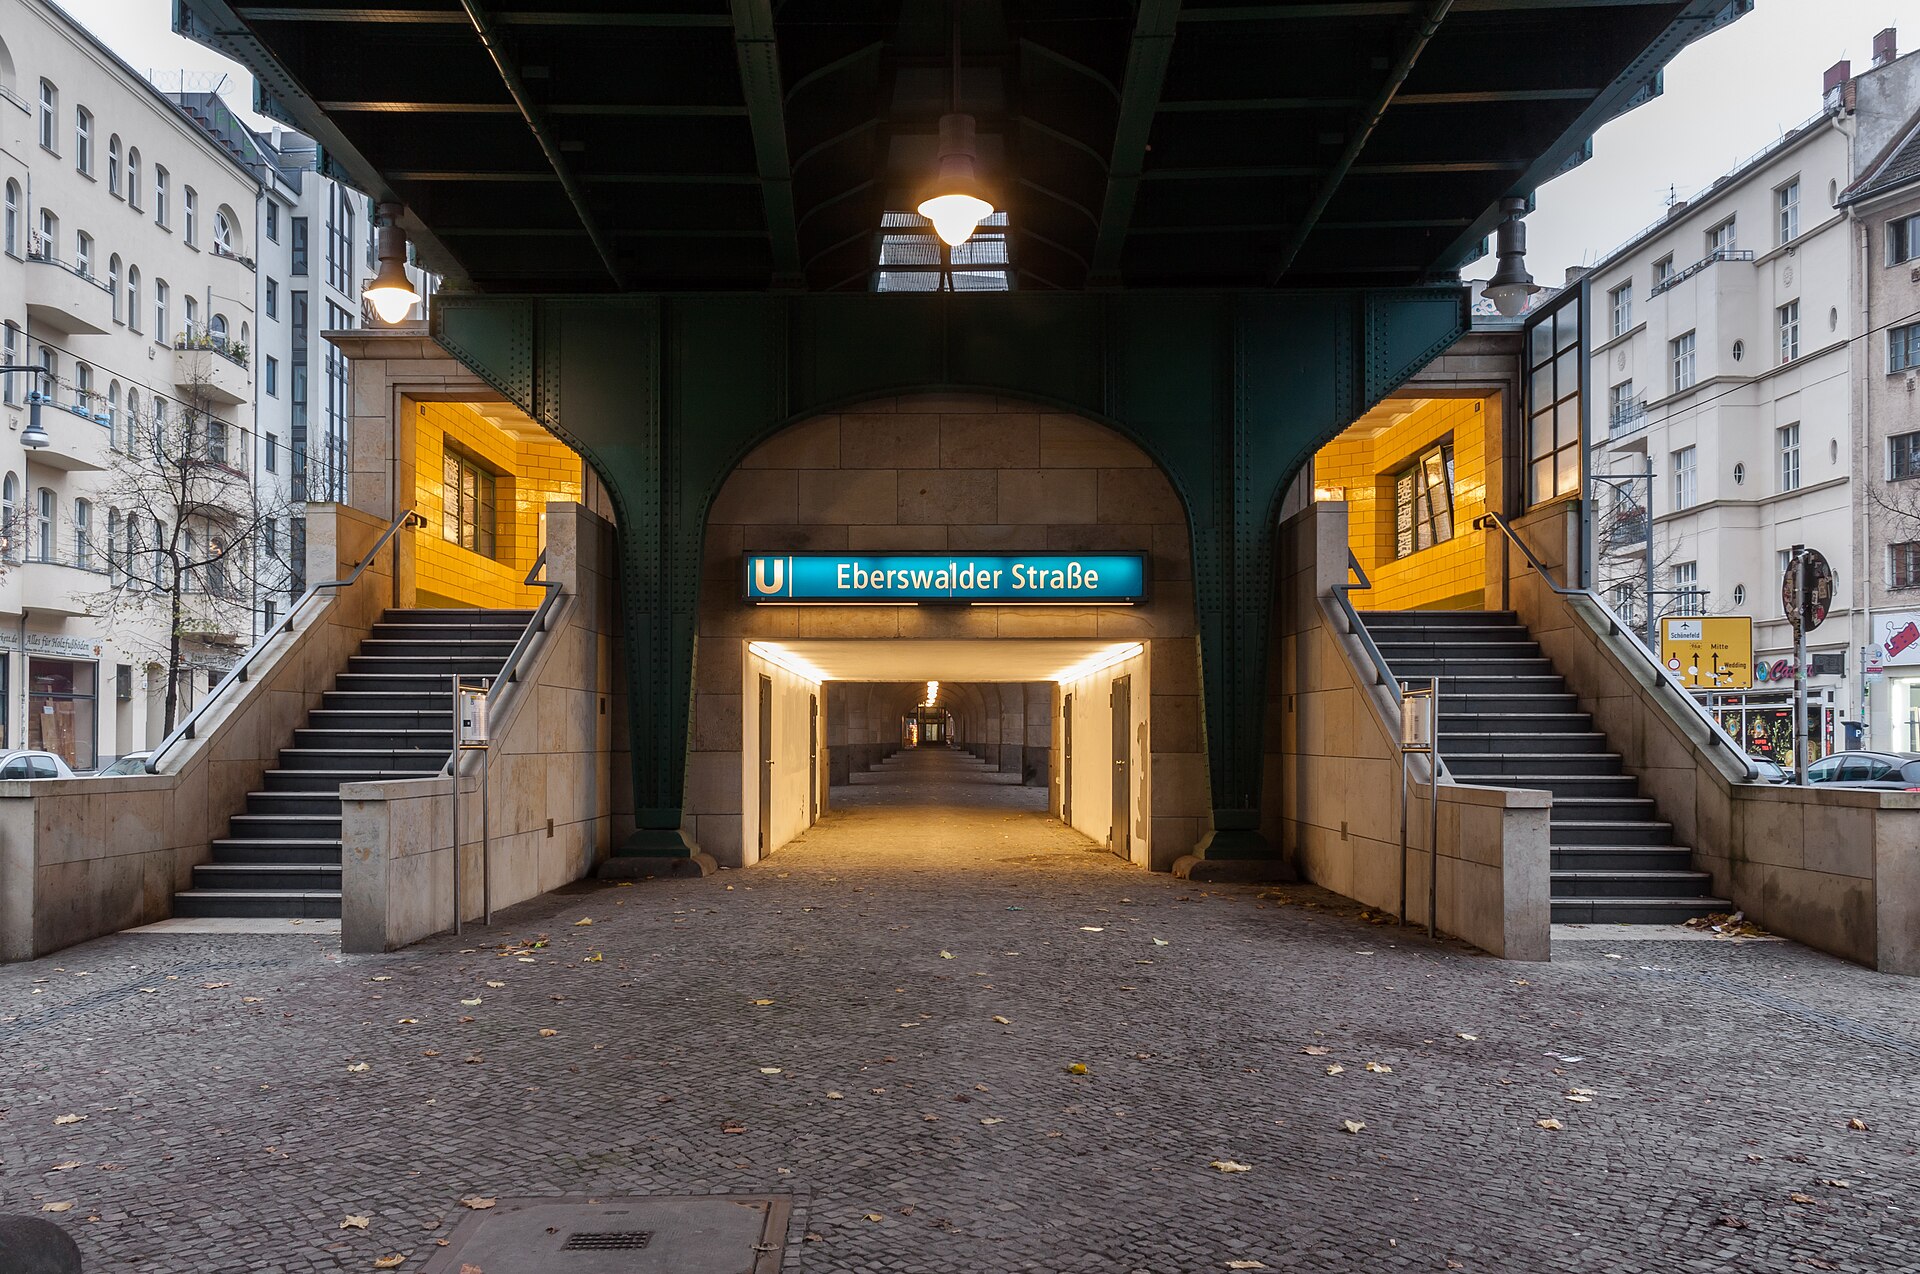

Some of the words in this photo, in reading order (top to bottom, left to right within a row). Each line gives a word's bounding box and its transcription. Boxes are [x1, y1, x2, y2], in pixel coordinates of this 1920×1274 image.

[754, 559, 784, 595] U
[836, 562, 1002, 590] Eberswalder
[1012, 562, 1099, 590] Straße
[26, 634, 40, 646] Alles
[42, 636, 51, 648] für
[51, 638, 89, 651] Holzfußböden
